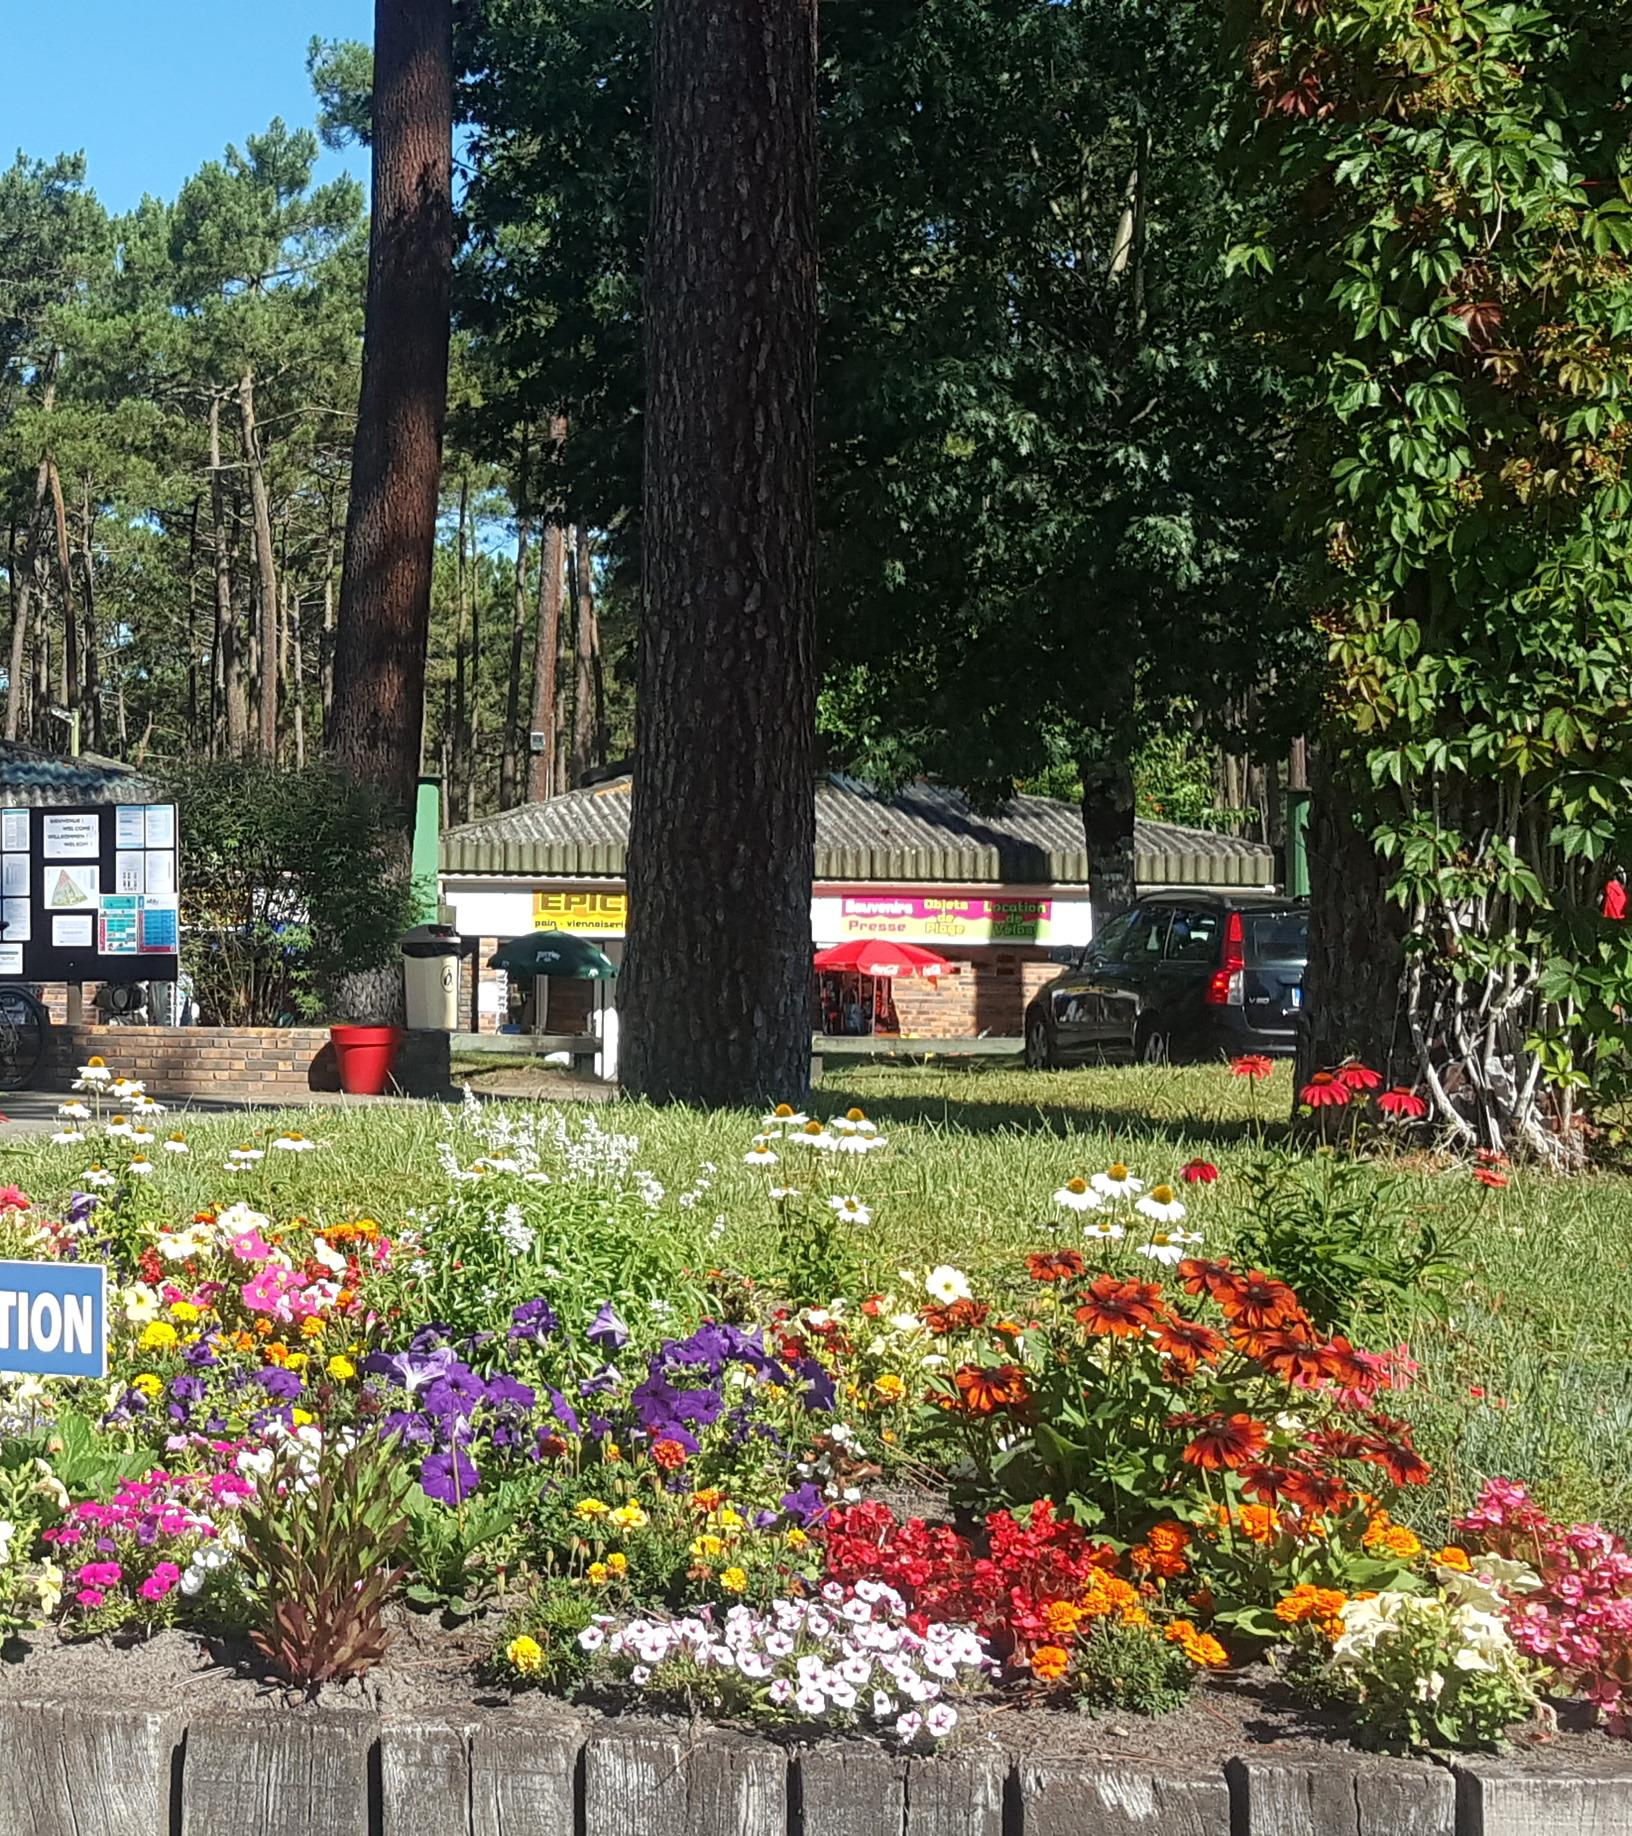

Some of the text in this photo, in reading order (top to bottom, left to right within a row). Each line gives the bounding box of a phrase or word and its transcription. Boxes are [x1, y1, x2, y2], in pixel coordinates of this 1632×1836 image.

[541, 893, 627, 912] EPIC
[983, 899, 1046, 914] Location
[535, 920, 557, 928] pain
[937, 913, 955, 924] de
[849, 919, 907, 932] Presse
[925, 923, 965, 936] Plage
